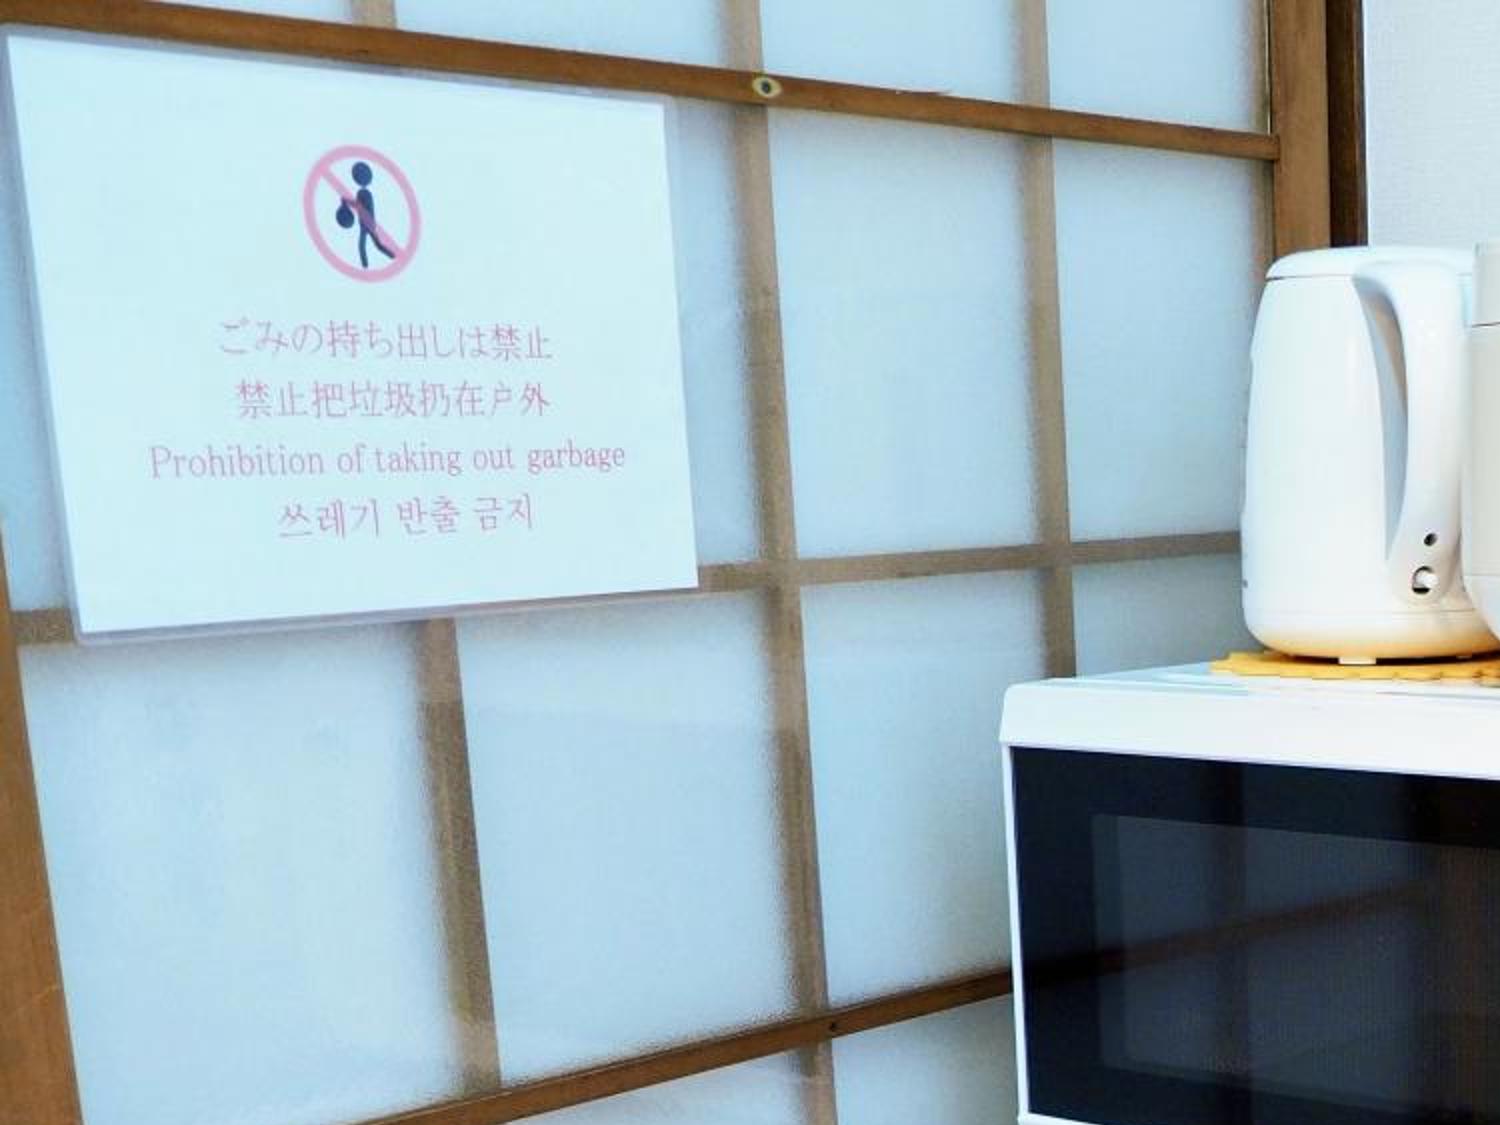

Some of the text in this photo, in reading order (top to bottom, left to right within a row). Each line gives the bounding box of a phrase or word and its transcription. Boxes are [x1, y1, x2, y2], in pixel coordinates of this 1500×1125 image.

[220, 317, 553, 361] ごみの持ち出しは禁止
[235, 379, 550, 419] 禁止把垃圾扔在户外
[150, 438, 625, 479] Prohibition of taking out garbage
[278, 492, 533, 539] 쓰레기 반출 금지
